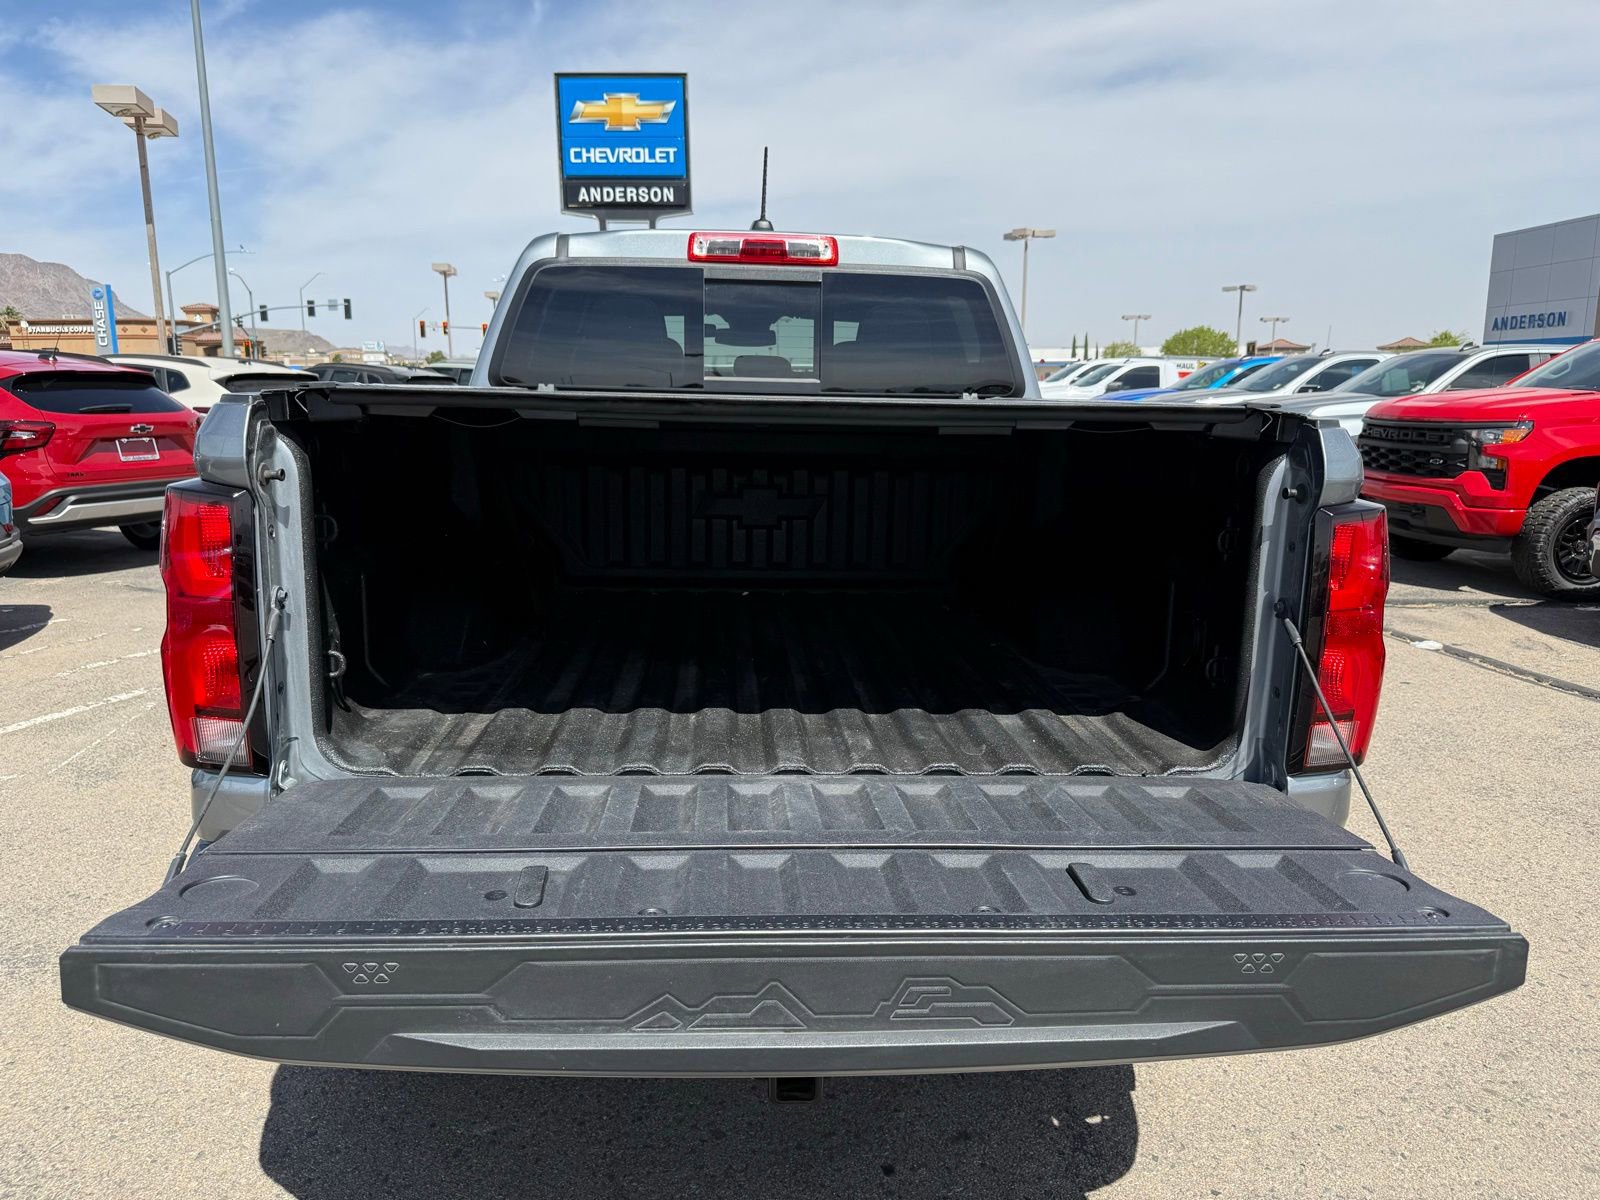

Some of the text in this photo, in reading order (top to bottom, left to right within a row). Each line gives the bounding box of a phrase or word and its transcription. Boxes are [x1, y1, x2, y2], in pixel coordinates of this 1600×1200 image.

[569, 146, 678, 164] CHEVROLET
[578, 186, 675, 203] ANDERSON
[28, 325, 69, 335] STARBUCKS
[93, 301, 109, 346] CHASE
[1491, 311, 1567, 332] ANDERSON
